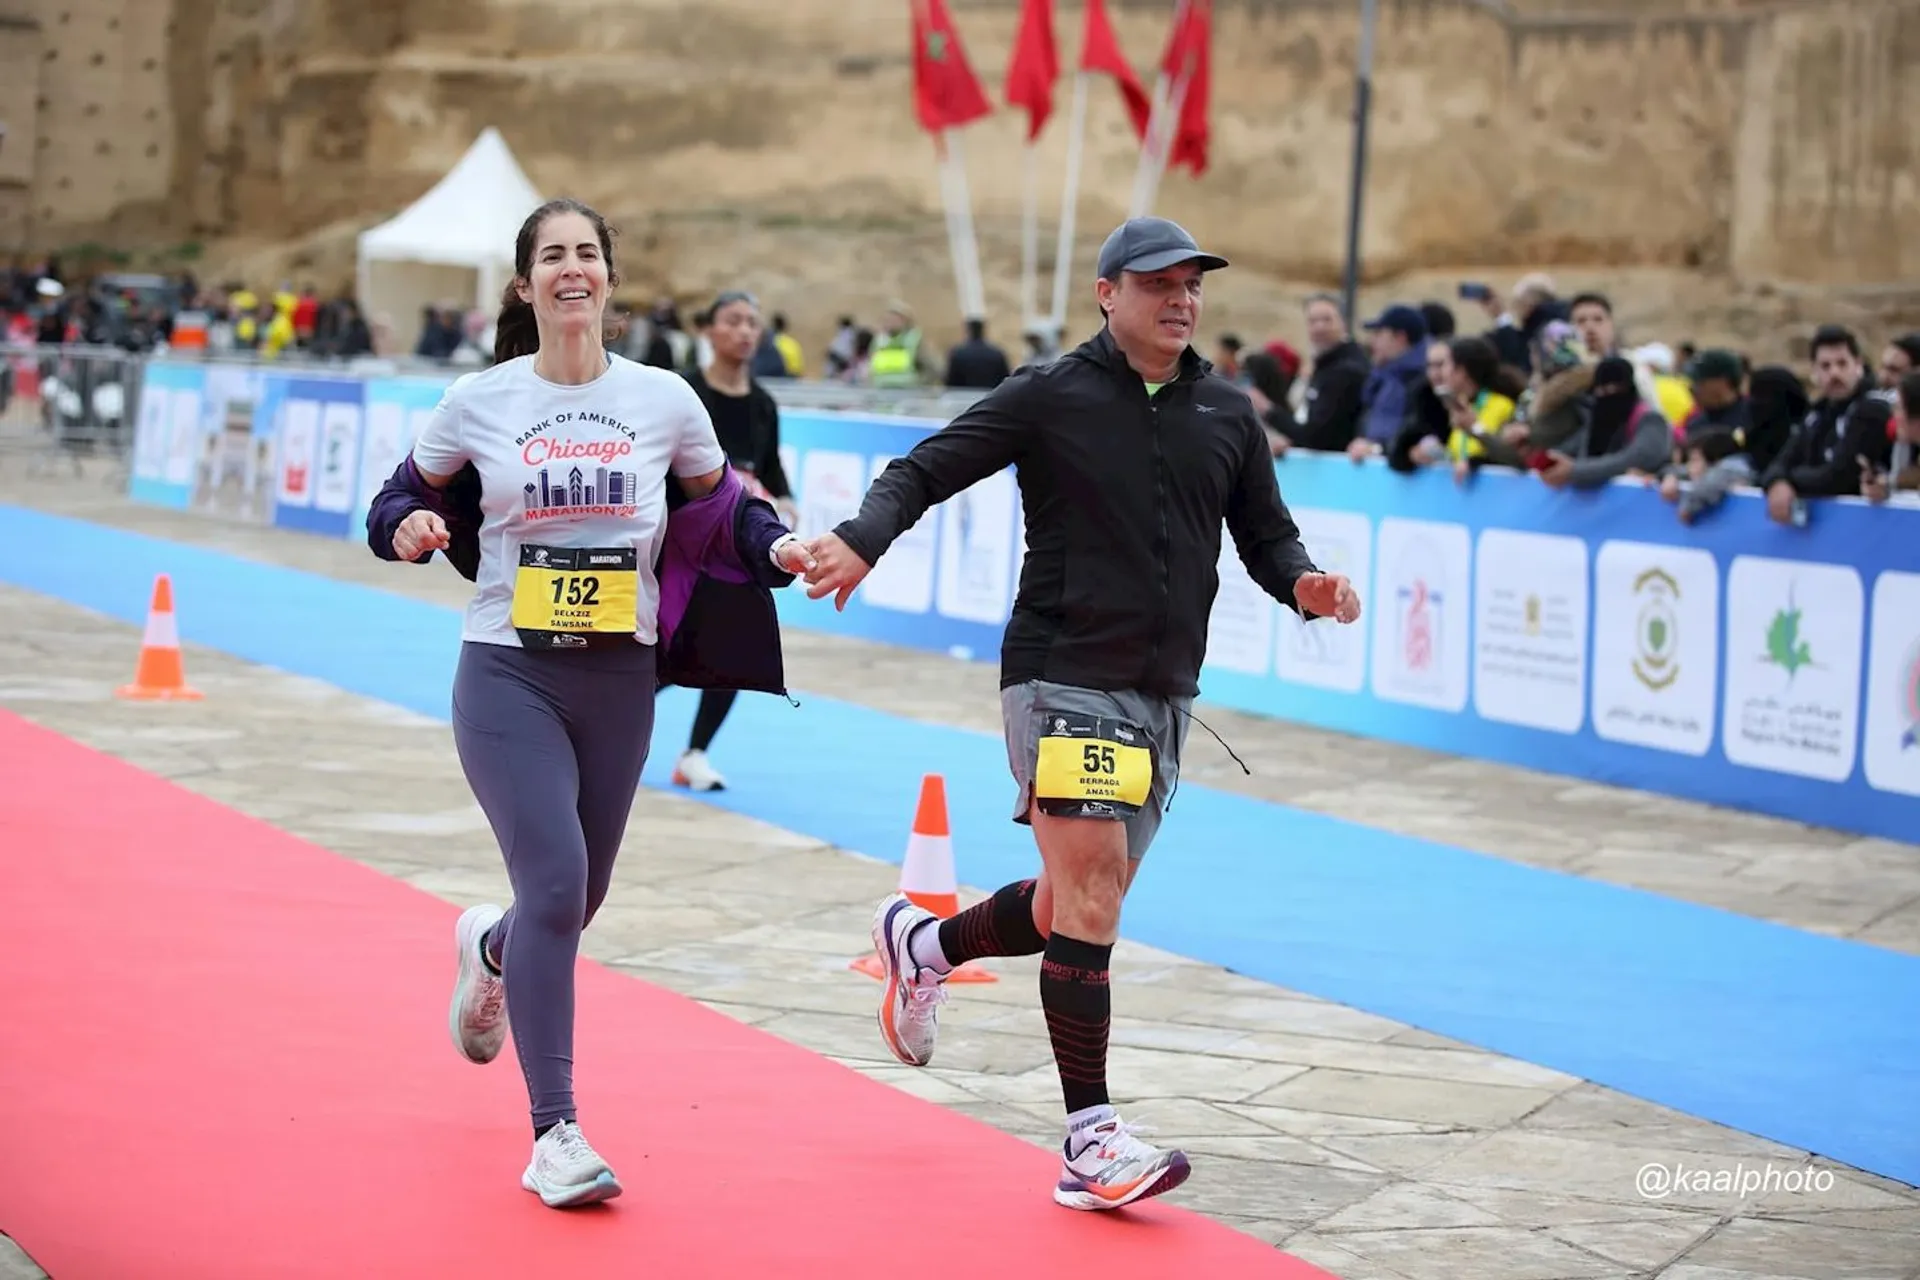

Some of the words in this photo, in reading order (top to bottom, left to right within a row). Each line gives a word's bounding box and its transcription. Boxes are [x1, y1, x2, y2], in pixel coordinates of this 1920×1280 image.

[515, 419, 551, 446] BANK
[555, 413, 573, 423] OF
[578, 411, 636, 442] AMERICA
[523, 438, 631, 466] Chicago
[526, 506, 615, 520] MARATHON
[590, 555, 622, 564] MARATHON
[551, 576, 600, 606] 152
[554, 609, 591, 618] BELKZIZ
[550, 620, 593, 628] SAWSANE
[1083, 744, 1115, 774] 55
[1079, 777, 1120, 787] BERRADA
[1085, 788, 1115, 796] ANASS
